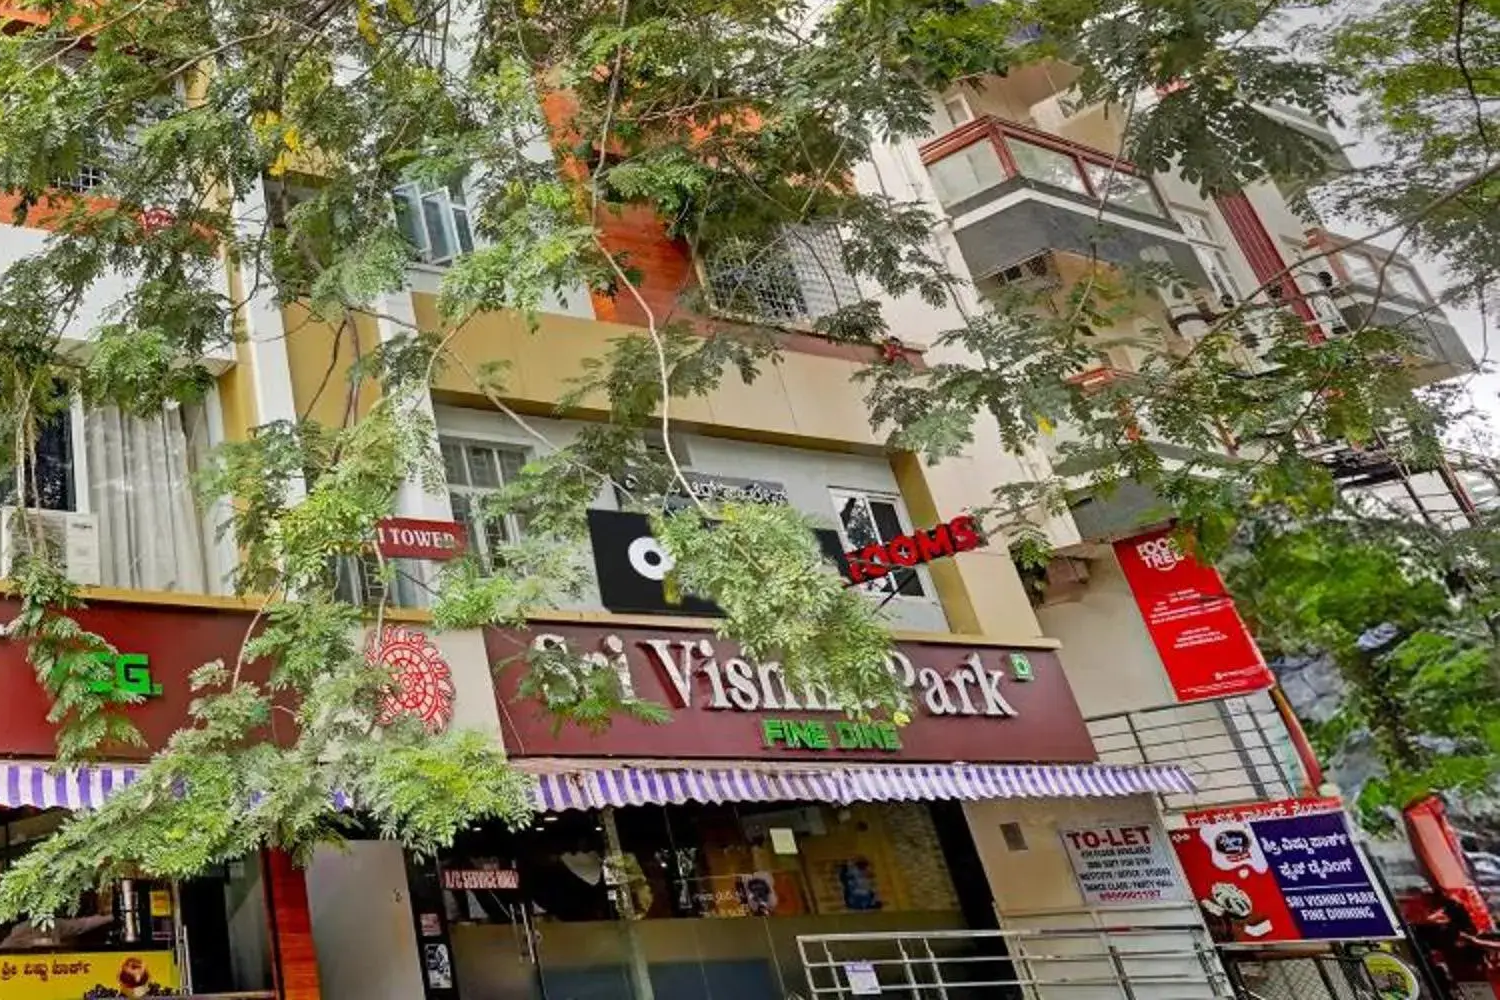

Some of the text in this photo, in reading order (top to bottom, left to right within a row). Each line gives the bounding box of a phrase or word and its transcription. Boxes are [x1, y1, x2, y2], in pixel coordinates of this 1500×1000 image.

[762, 718, 903, 751] FINE DINE
[1066, 825, 1151, 850] TO-LET
[1305, 892, 1347, 907] VISHNU
[1346, 890, 1380, 905] PARK
[1300, 908, 1328, 921] FINE
